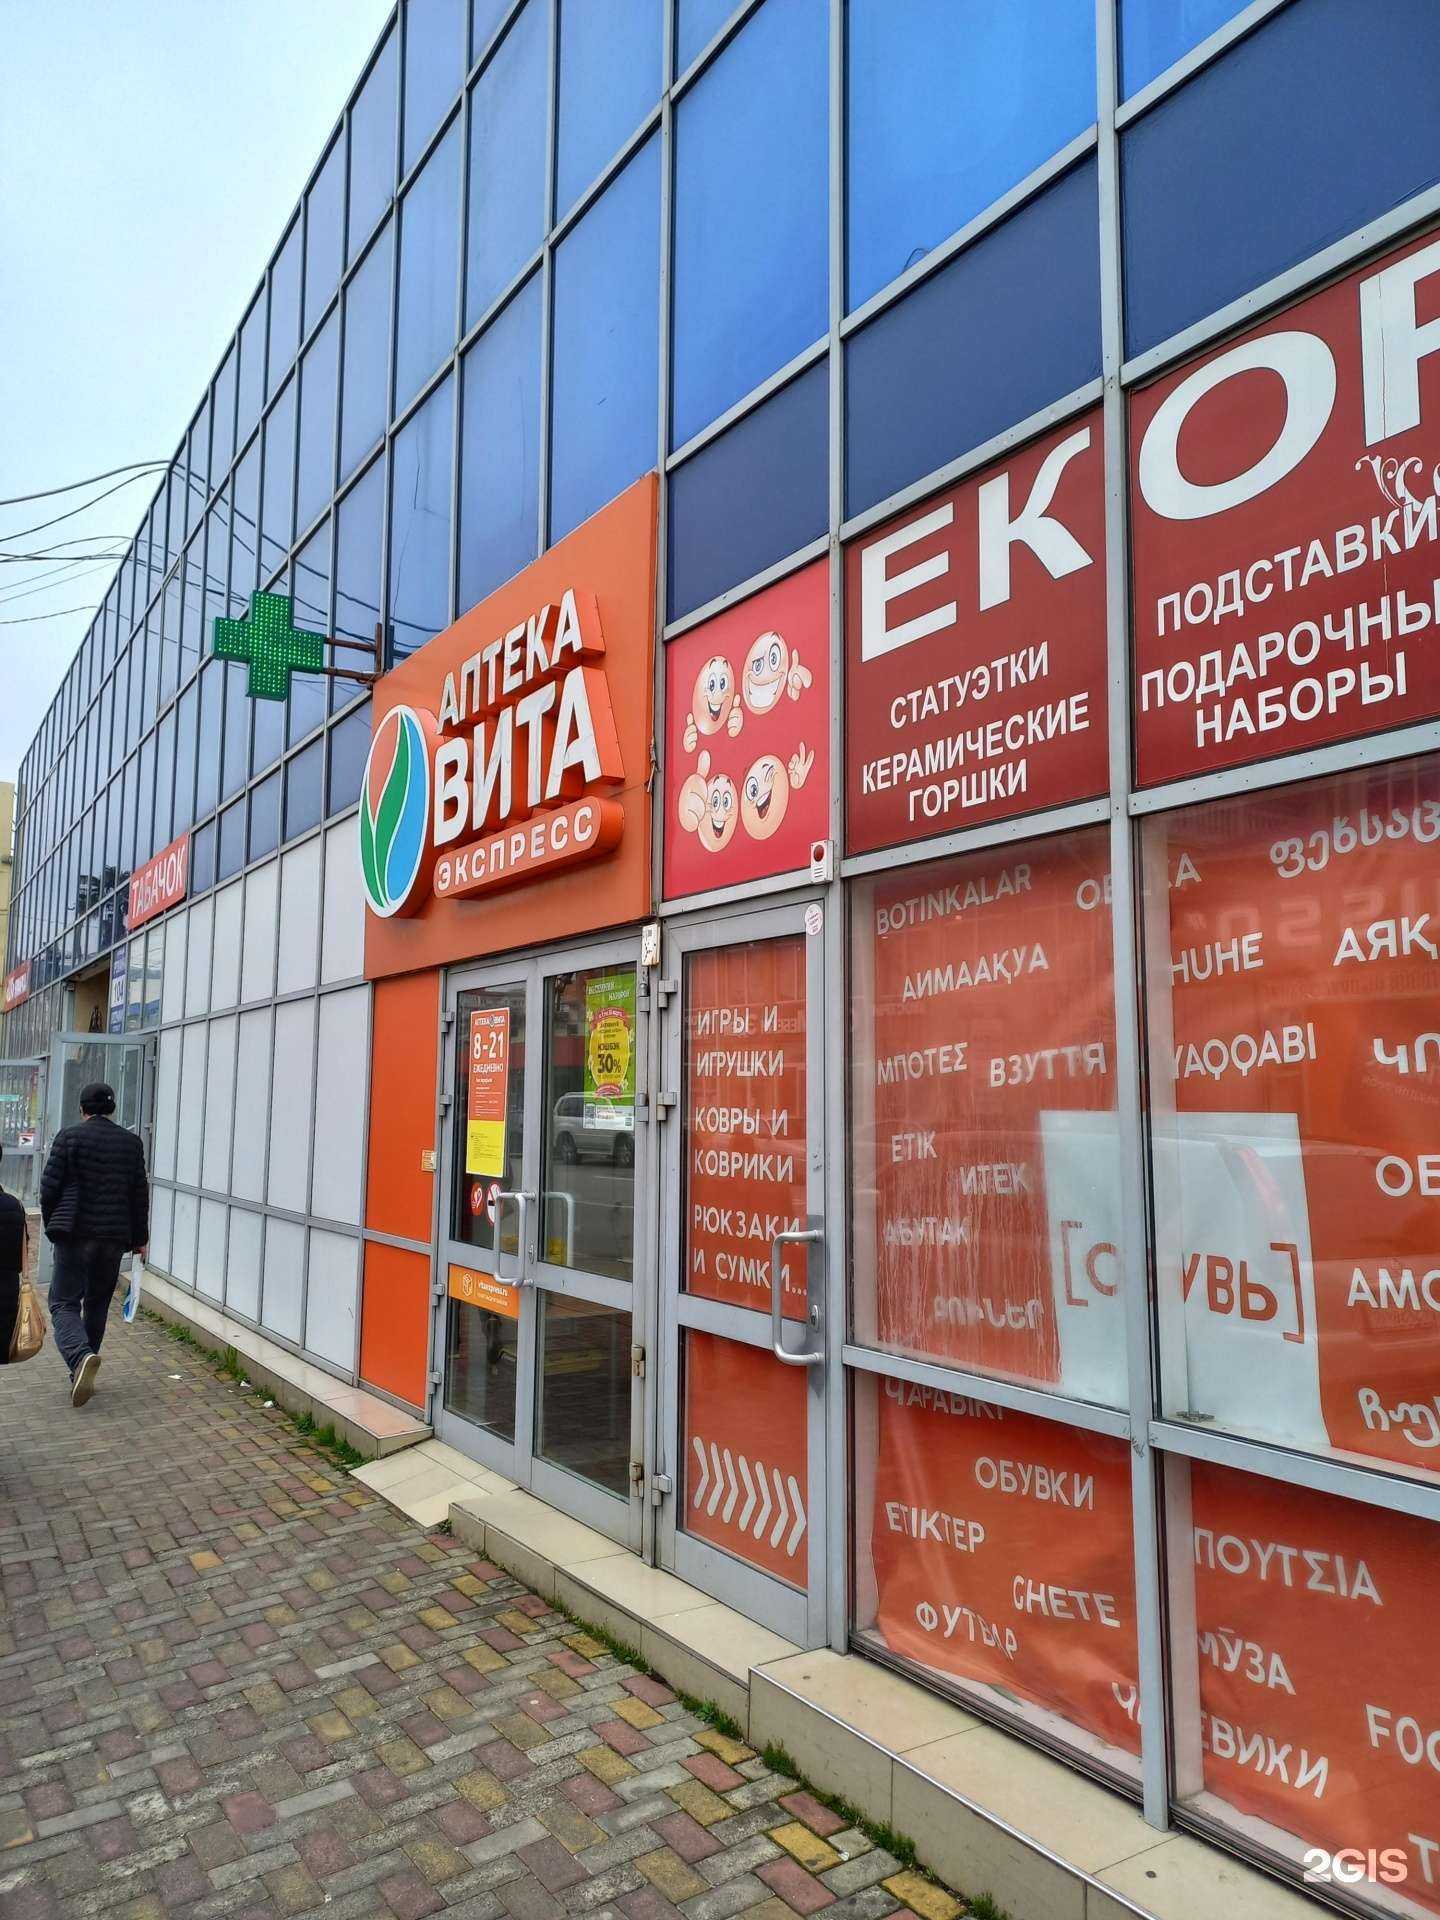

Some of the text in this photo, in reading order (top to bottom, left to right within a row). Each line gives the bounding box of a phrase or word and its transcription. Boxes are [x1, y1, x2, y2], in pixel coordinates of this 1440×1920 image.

[1157, 495, 1438, 637] ПОДСТАВКИ
[437, 588, 583, 735] АПТЕКА
[890, 641, 1048, 729] СТАТУЭТКИ
[1196, 652, 1407, 747] НАБОРЫ
[433, 665, 602, 847] ВИТА
[862, 692, 1090, 794] КЕРАМИЧЕСКИЕ
[909, 760, 1027, 821] ГОРШКИ
[437, 806, 592, 891] ЭКСПРЕСС
[132, 844, 185, 919] ТАБАЧОК
[877, 864, 1032, 935] BOTINKALAR
[473, 1031, 504, 1059] 8-21
[697, 1005, 778, 1035] ИГРЫ И
[597, 1053, 622, 1074] 30%
[696, 1049, 784, 1077] ИГРУШКИ
[989, 1042, 1107, 1088] ВЗУТТЯ
[695, 1106, 788, 1137] КОВРЫ И
[694, 1148, 794, 1183] КОВРИКИ
[694, 1204, 800, 1246] РЮКЗАКИ
[694, 1248, 706, 1274] И
[974, 1456, 1094, 1511] ОБУВКИ
